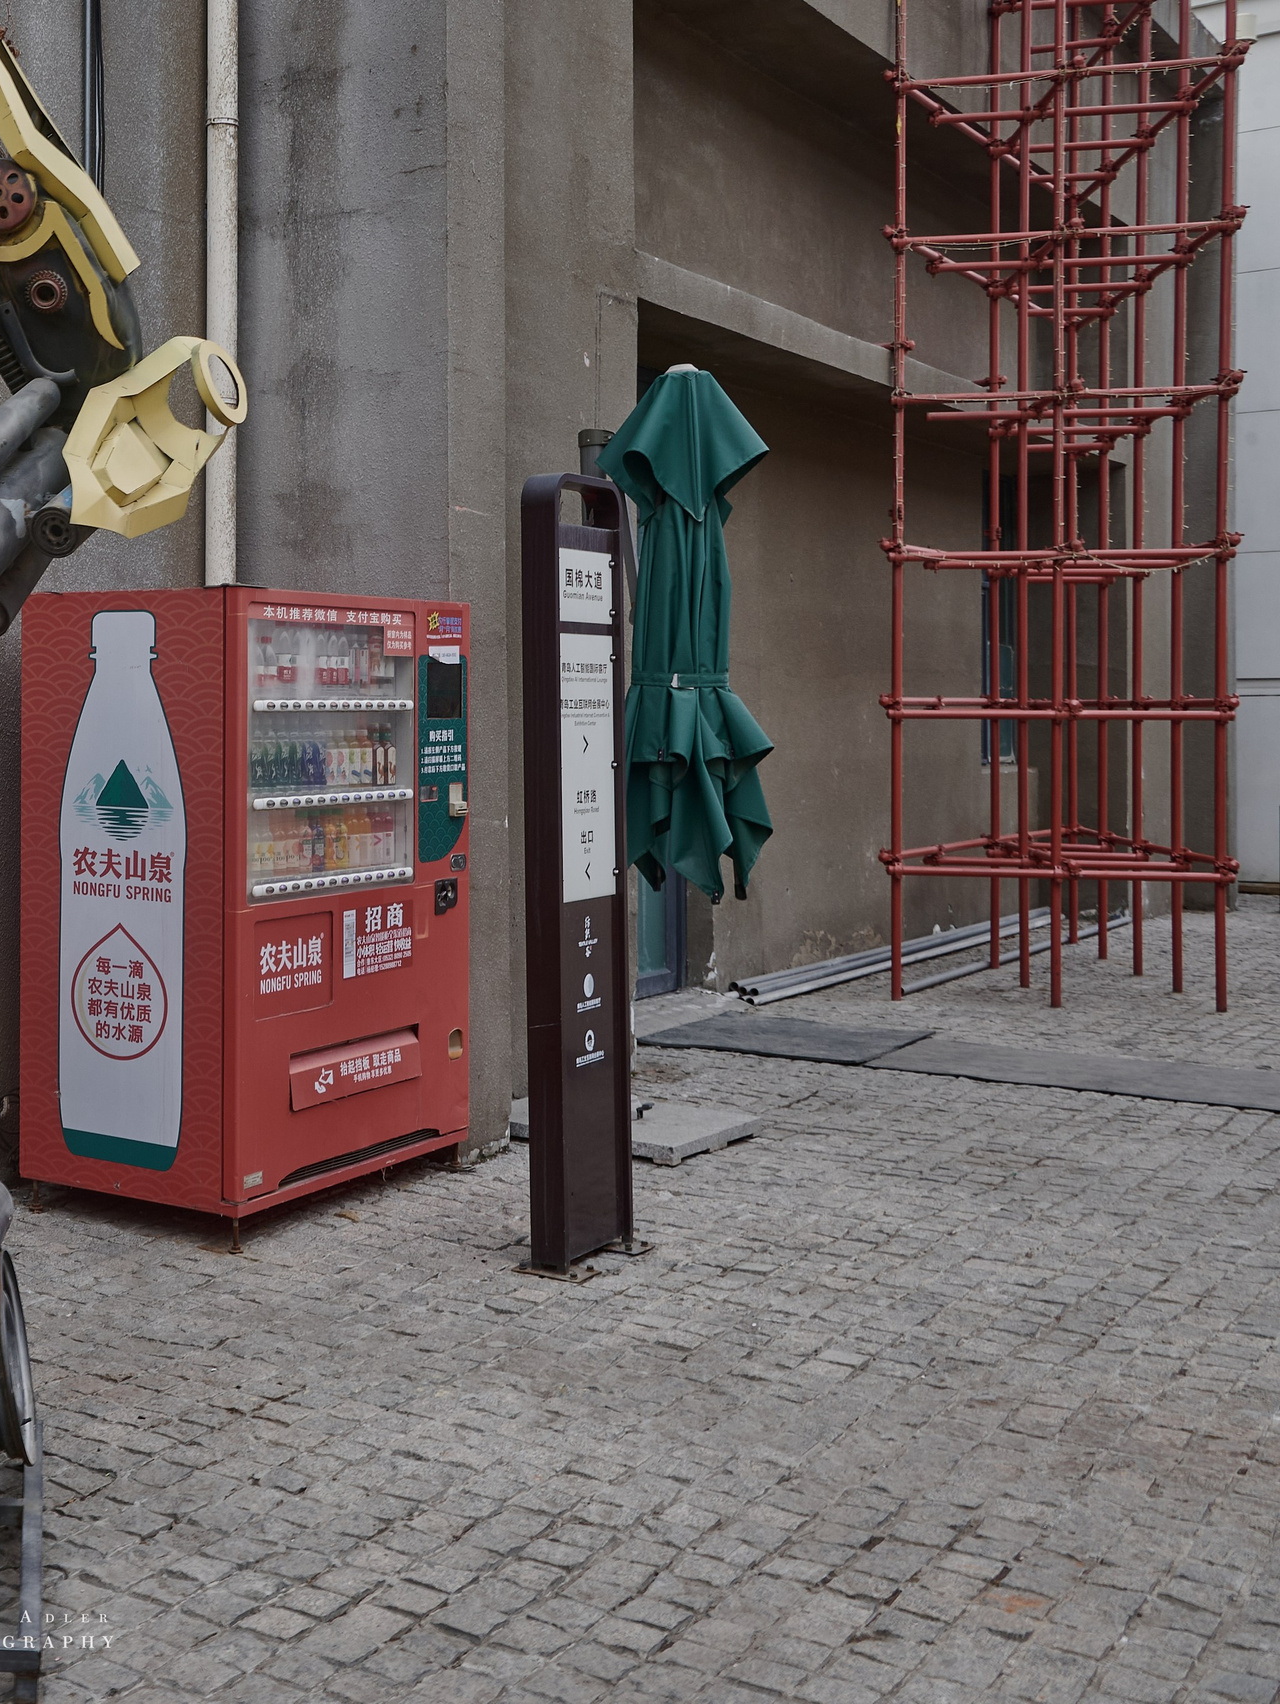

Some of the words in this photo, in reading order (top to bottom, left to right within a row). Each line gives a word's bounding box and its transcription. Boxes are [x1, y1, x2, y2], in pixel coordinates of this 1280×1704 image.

[565, 568, 603, 590] 国棉大道
[263, 605, 338, 622] 本机推荐微信
[346, 610, 402, 625] 支付宝购买
[429, 729, 454, 742] 购买指引
[576, 789, 597, 804] 虹桥路
[580, 830, 594, 844] 出口
[583, 847, 591, 855] Exit
[72, 846, 173, 884] 农夫山泉
[73, 881, 121, 899] NONGFU
[125, 885, 172, 903] SPRING
[365, 902, 404, 934] 招商
[260, 935, 323, 976] 农夫山泉
[96, 956, 144, 979] 每一滴
[88, 977, 152, 1001] 农夫山泉
[260, 974, 292, 995] NONGFU
[293, 969, 322, 989] SPRING
[87, 998, 152, 1023] 都有优质
[95, 1020, 143, 1043] 的水源
[372, 1048, 402, 1068] 取走商品
